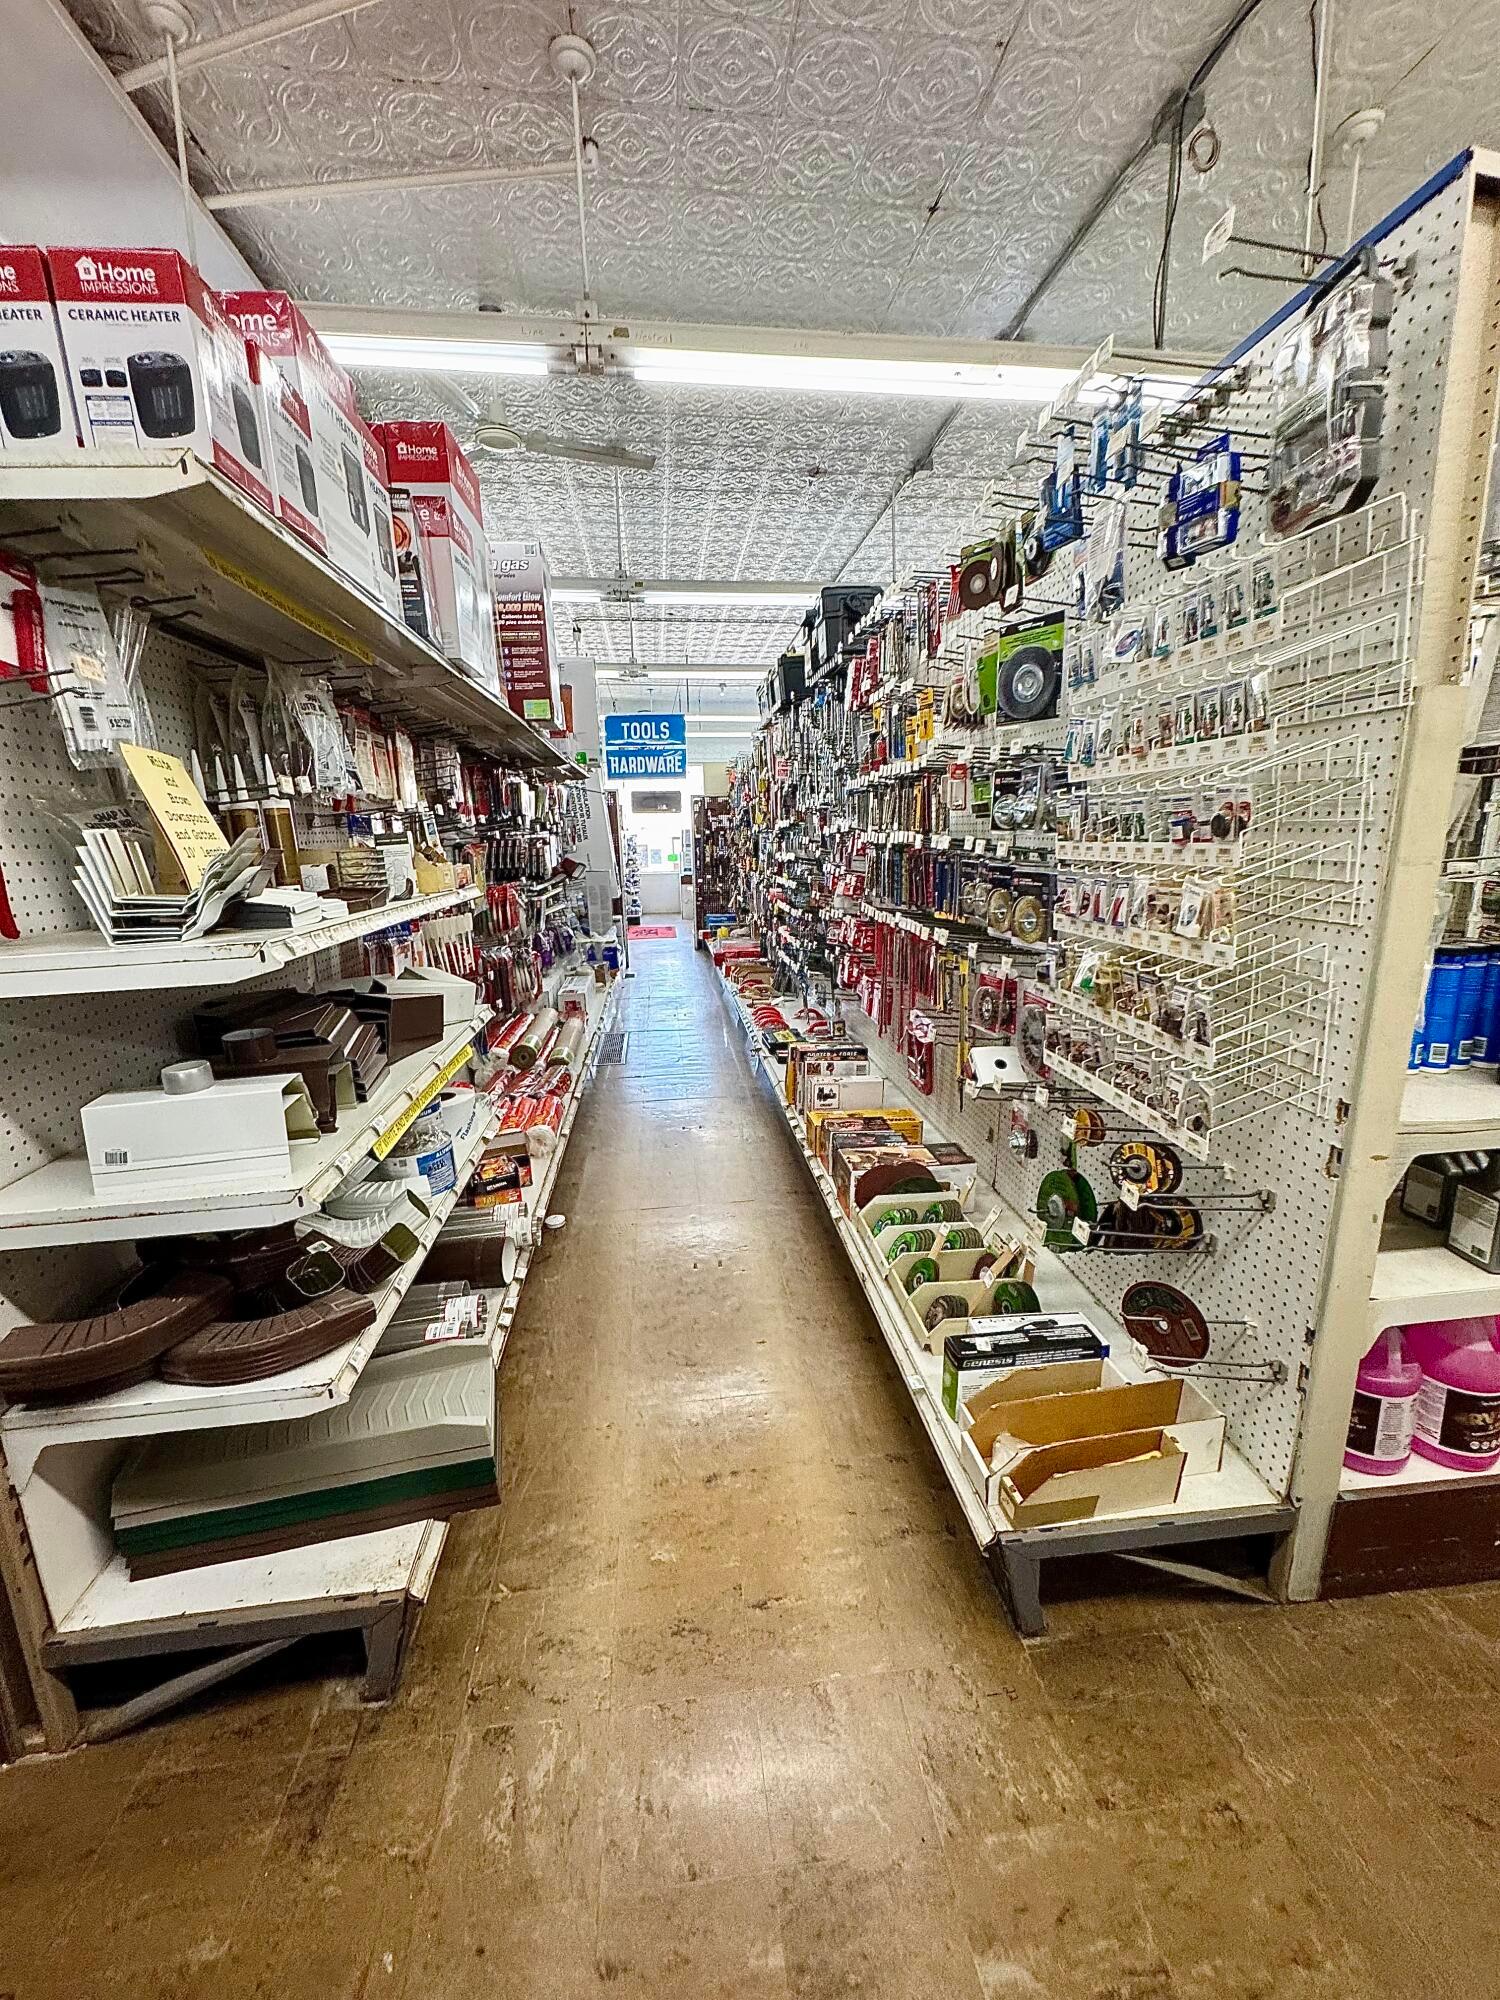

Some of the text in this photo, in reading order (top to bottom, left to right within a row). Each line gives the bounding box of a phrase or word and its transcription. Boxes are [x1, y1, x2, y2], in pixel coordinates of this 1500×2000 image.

[97, 262, 156, 281] Home
[81, 280, 159, 295] IMPRESSIONS
[0, 308, 43, 320] EATER
[68, 308, 180, 323] CERAMIC HEATER
[407, 444, 438, 455] Home
[501, 560, 529, 573] gas
[621, 722, 670, 740] TOOLS
[608, 755, 683, 774] HARDWARE
